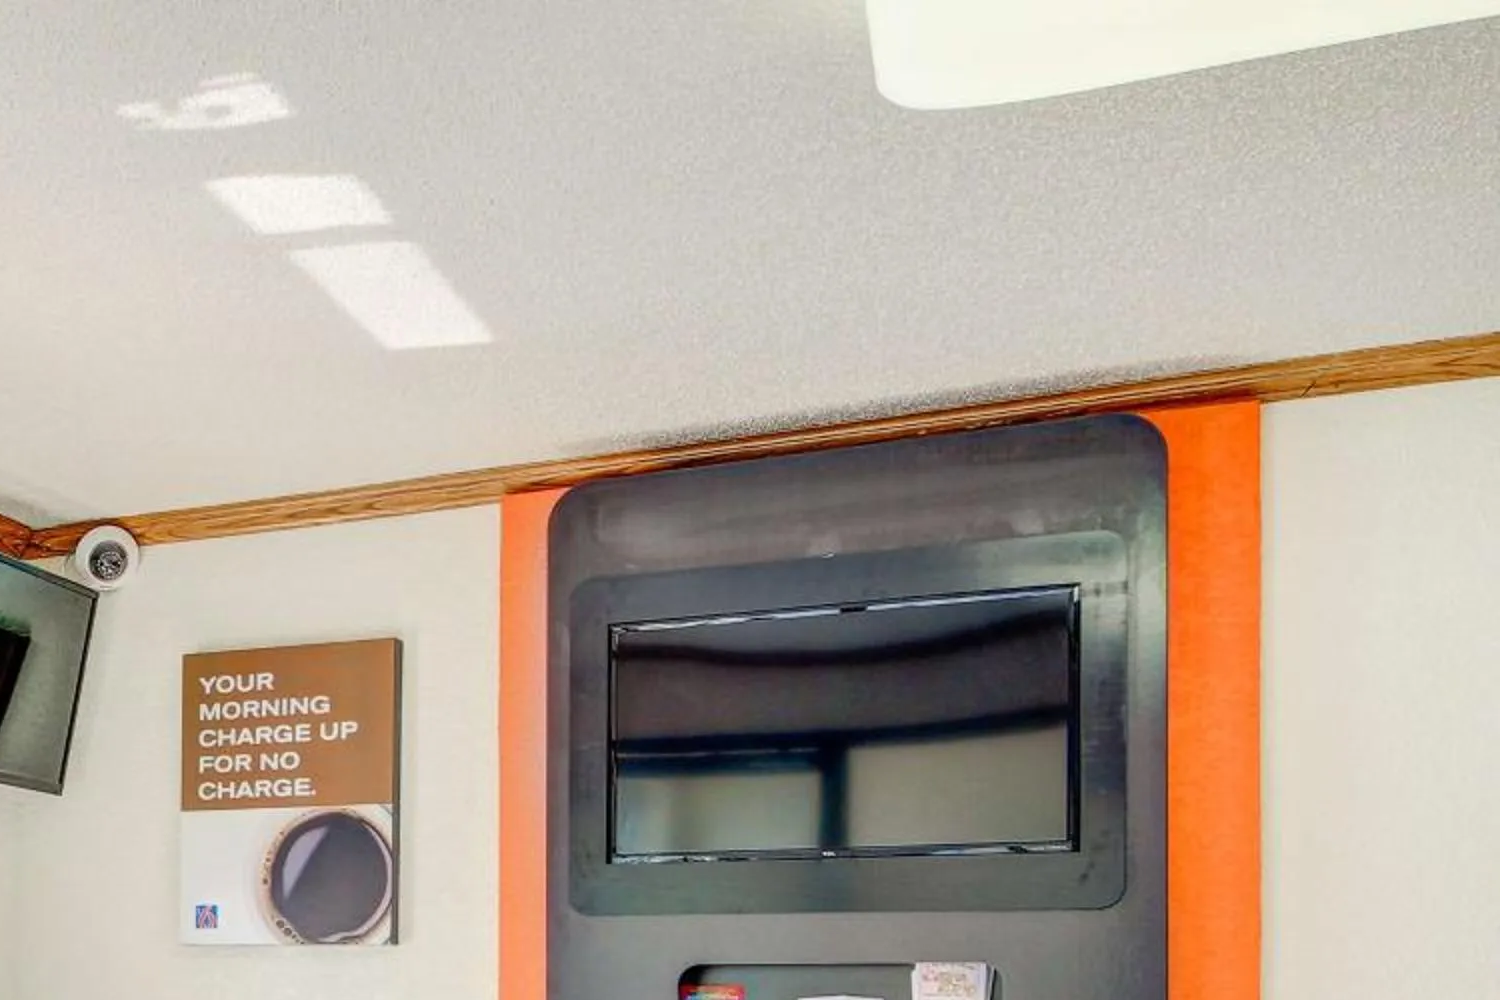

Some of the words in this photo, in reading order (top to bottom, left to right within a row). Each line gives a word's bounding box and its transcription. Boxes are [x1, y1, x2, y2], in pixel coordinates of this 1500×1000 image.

[199, 672, 275, 695] YOUR
[199, 695, 331, 721] MORNING
[199, 723, 312, 747] CHARGE
[319, 721, 359, 741] UP
[199, 754, 253, 774] FOR
[259, 751, 301, 771] NO
[198, 778, 317, 801] CHARGE.
